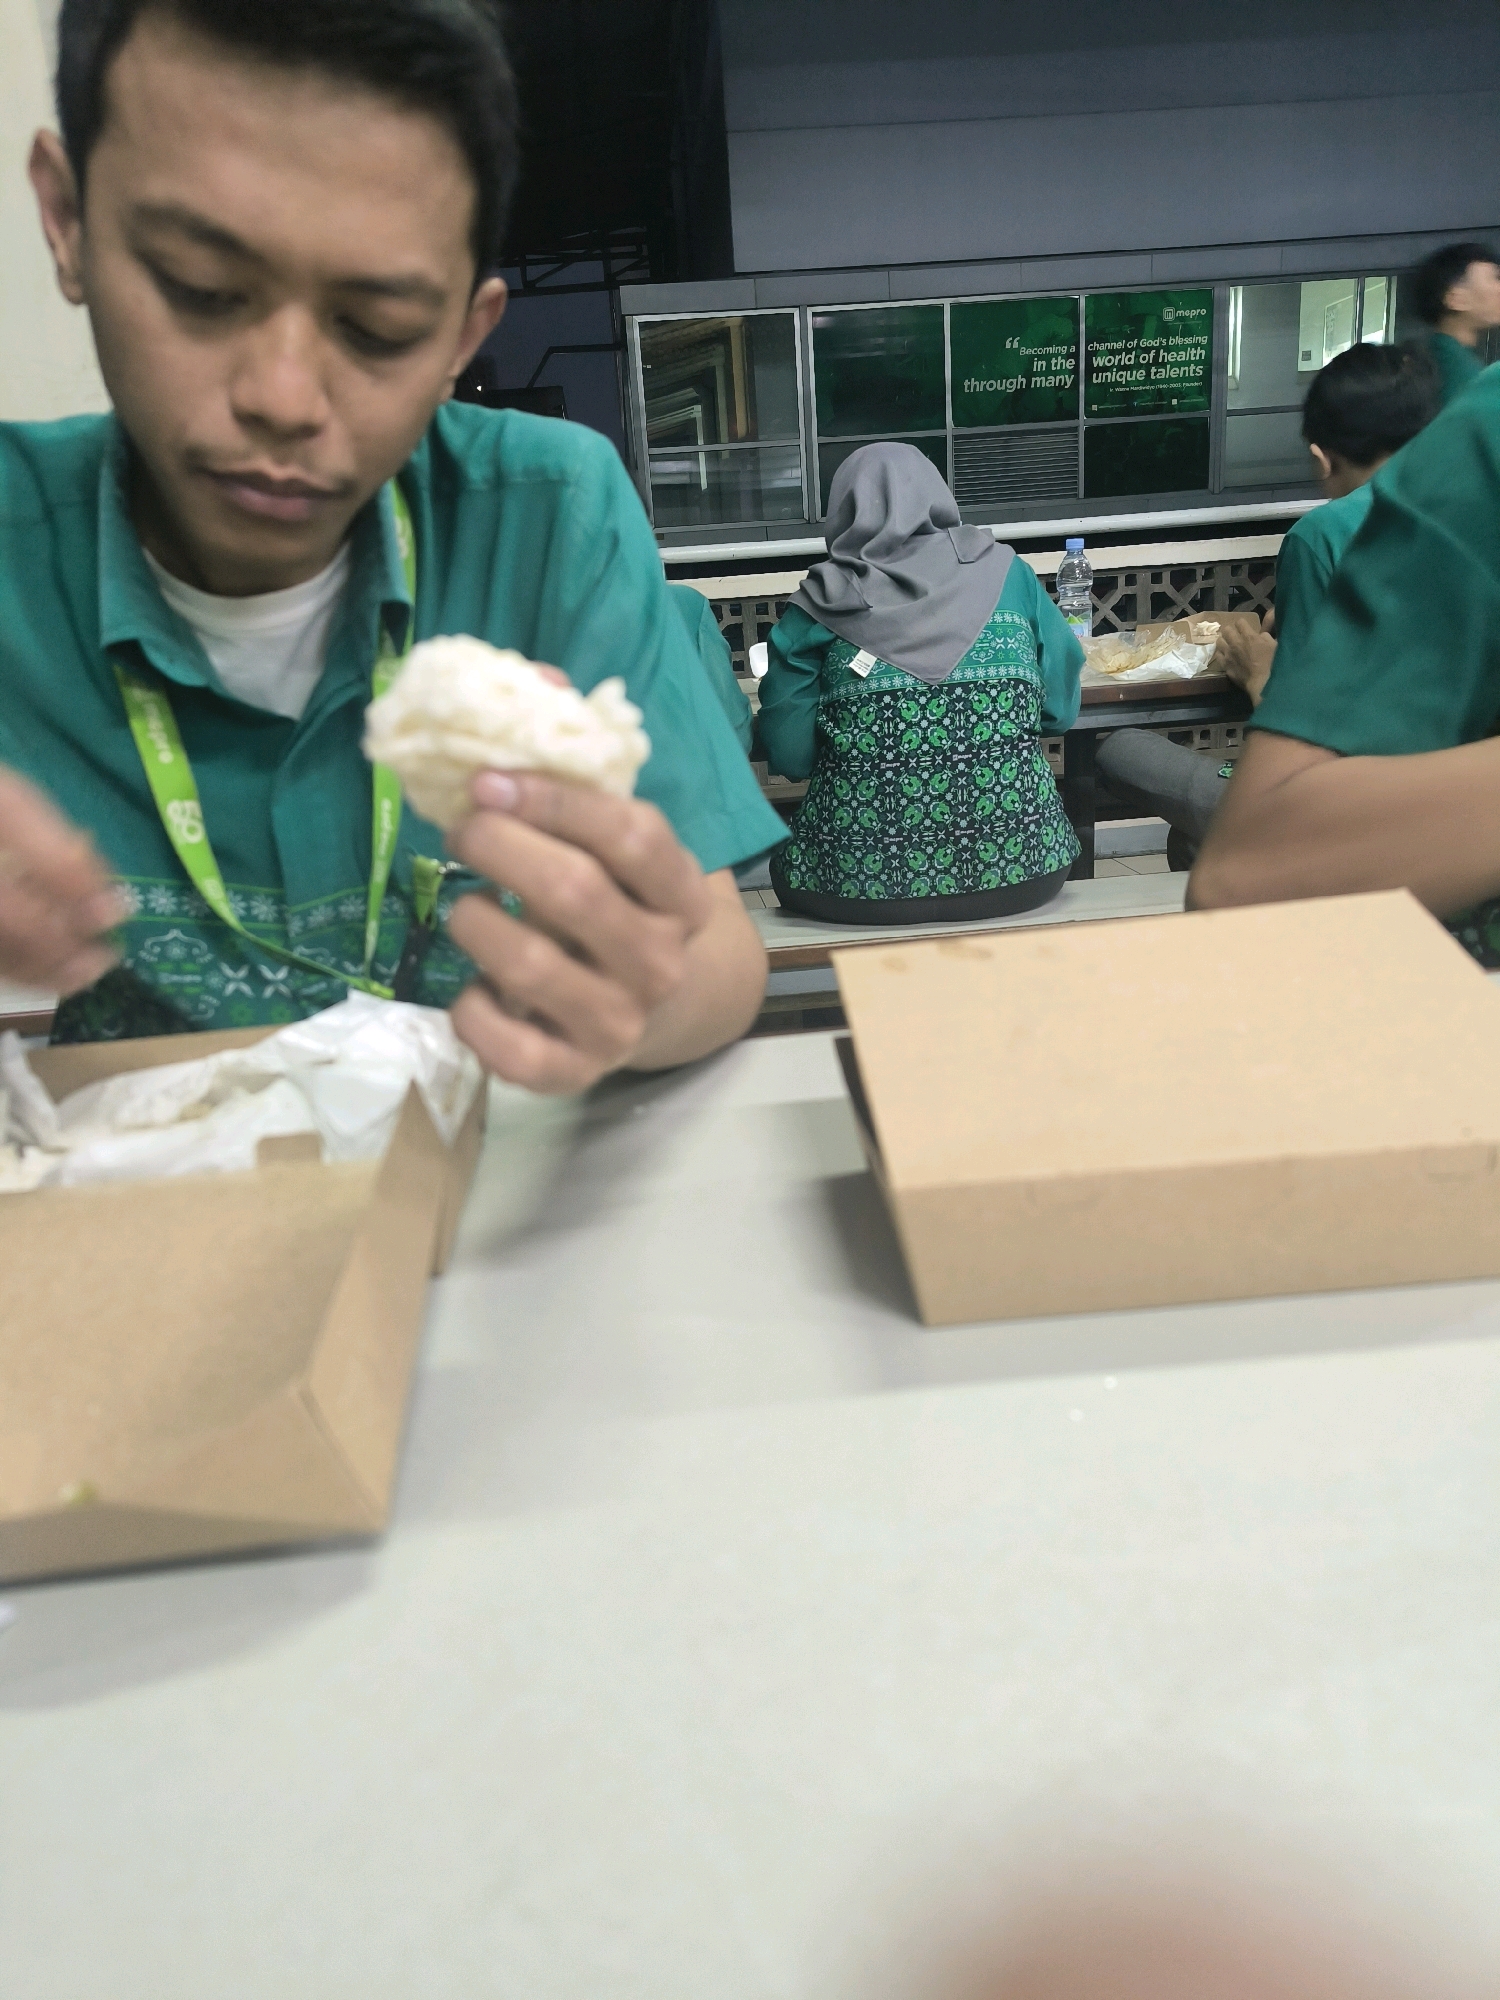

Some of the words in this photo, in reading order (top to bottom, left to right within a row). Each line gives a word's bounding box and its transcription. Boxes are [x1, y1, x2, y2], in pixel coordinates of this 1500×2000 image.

[1176, 308, 1206, 319] mepro
[1069, 345, 1076, 353] a
[1087, 340, 1125, 351] channel
[1127, 339, 1138, 349] of
[1140, 337, 1167, 347] God's
[1168, 335, 1208, 346] blessing
[1032, 358, 1046, 372] in
[1051, 356, 1076, 371] the
[1092, 350, 1136, 368] world
[1139, 349, 1156, 364] of
[1159, 347, 1206, 363] health
[963, 375, 1026, 393] through
[1031, 374, 1075, 389] many
[1092, 368, 1146, 384] unique
[1150, 363, 1204, 379] talents
